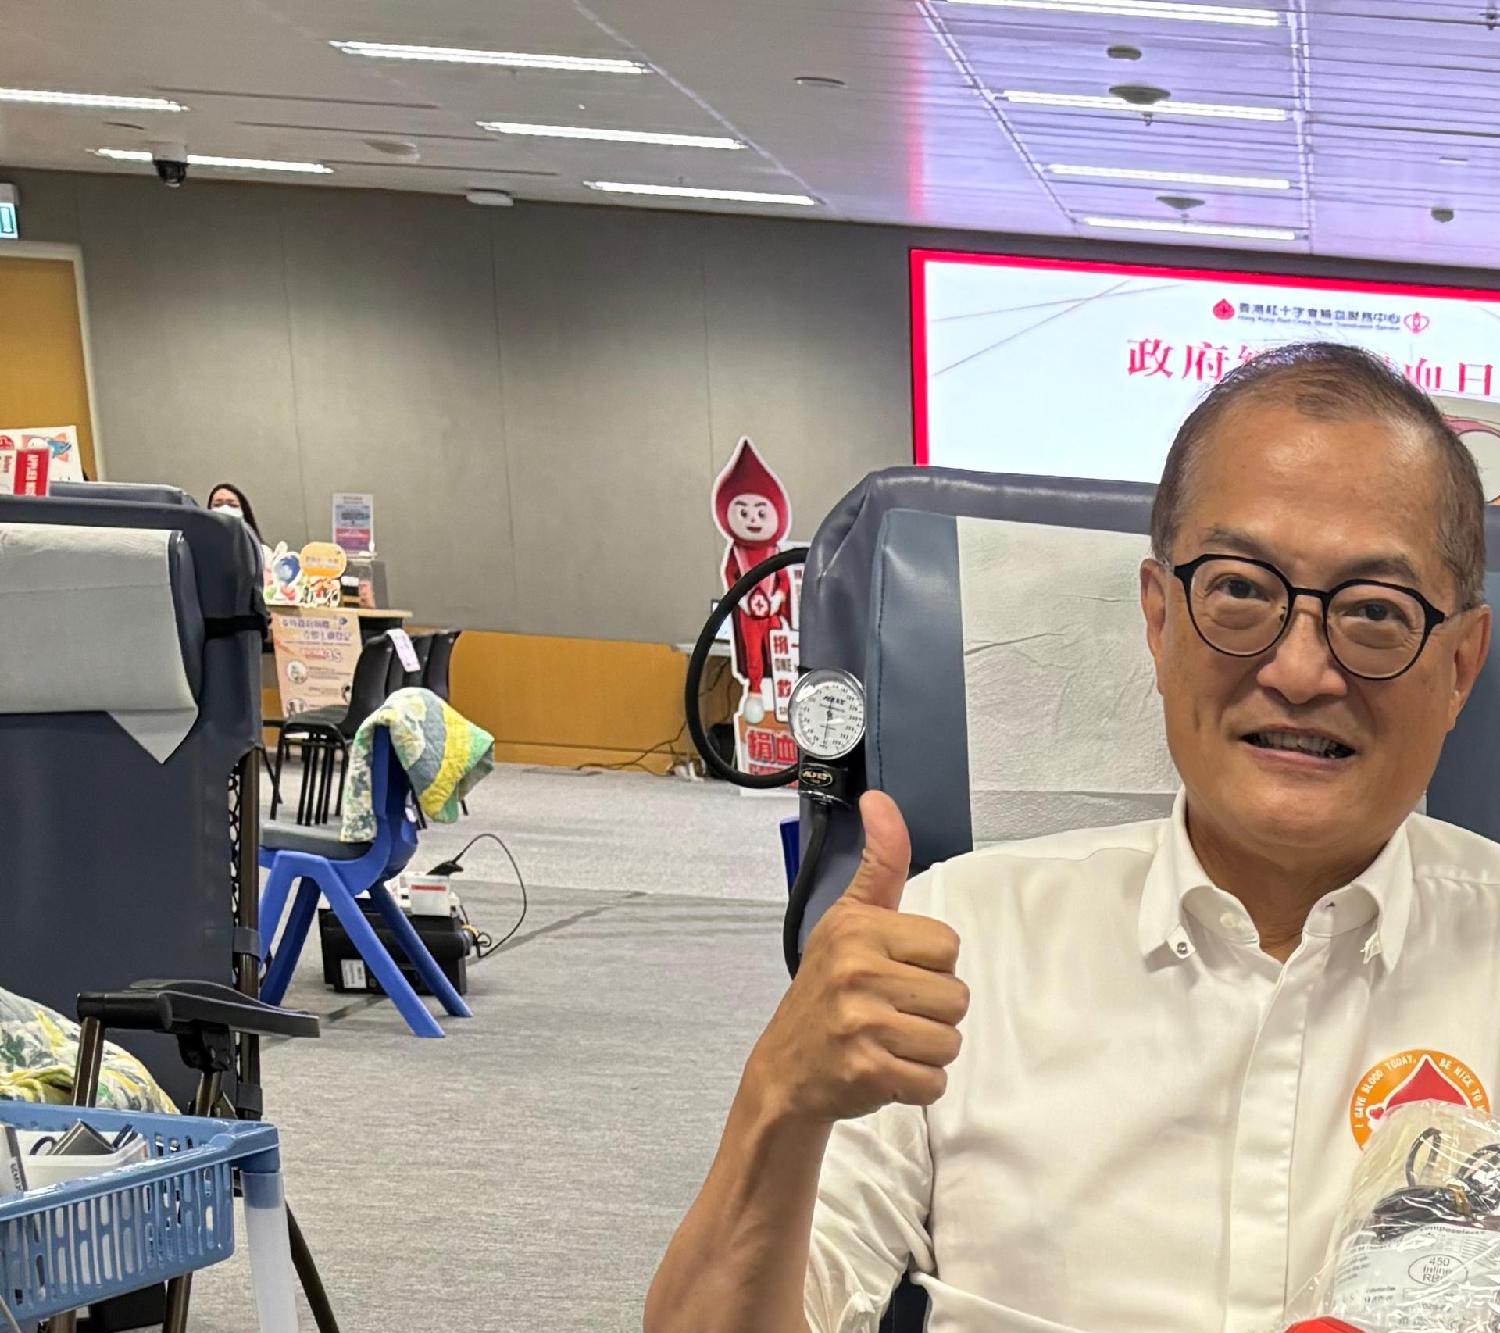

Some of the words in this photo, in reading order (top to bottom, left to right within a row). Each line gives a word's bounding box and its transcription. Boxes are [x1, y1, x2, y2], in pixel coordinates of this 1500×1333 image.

[1354, 1096, 1367, 1118] GAVE
[1361, 1069, 1384, 1094] BLOOD
[1440, 1057, 1452, 1070] BE
[1454, 1066, 1473, 1087] NICE
[1472, 1089, 1483, 1102] TO
[1429, 1257, 1450, 1267] 450
